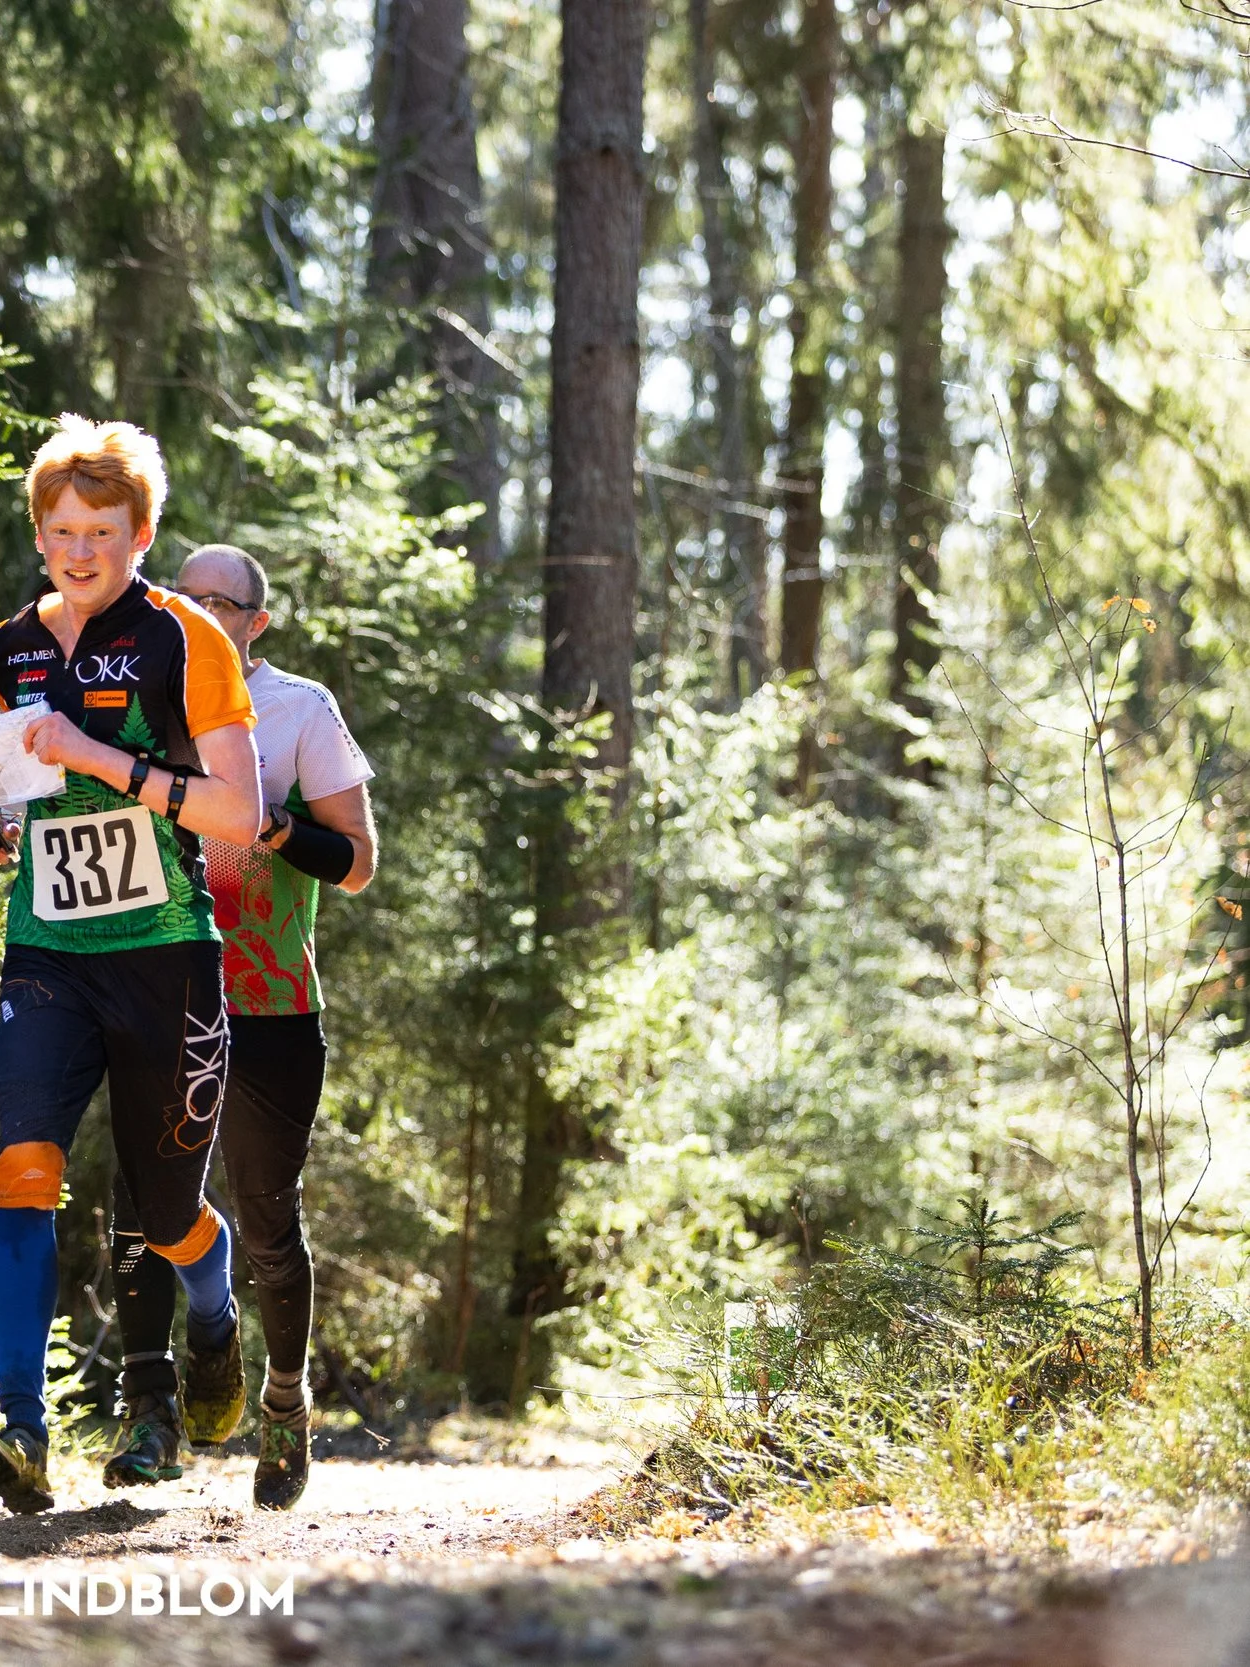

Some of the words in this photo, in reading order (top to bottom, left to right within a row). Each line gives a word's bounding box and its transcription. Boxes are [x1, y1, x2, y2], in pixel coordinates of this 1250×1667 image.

[7, 648, 57, 666] HOLMEN
[75, 655, 141, 684] OKK
[16, 692, 46, 705] TRIMTEX
[278, 680, 327, 703] MOUNTAIN
[327, 706, 343, 730] BIKE
[342, 733, 358, 759] RACE
[44, 817, 149, 911] 332
[184, 1008, 224, 1122] OKK
